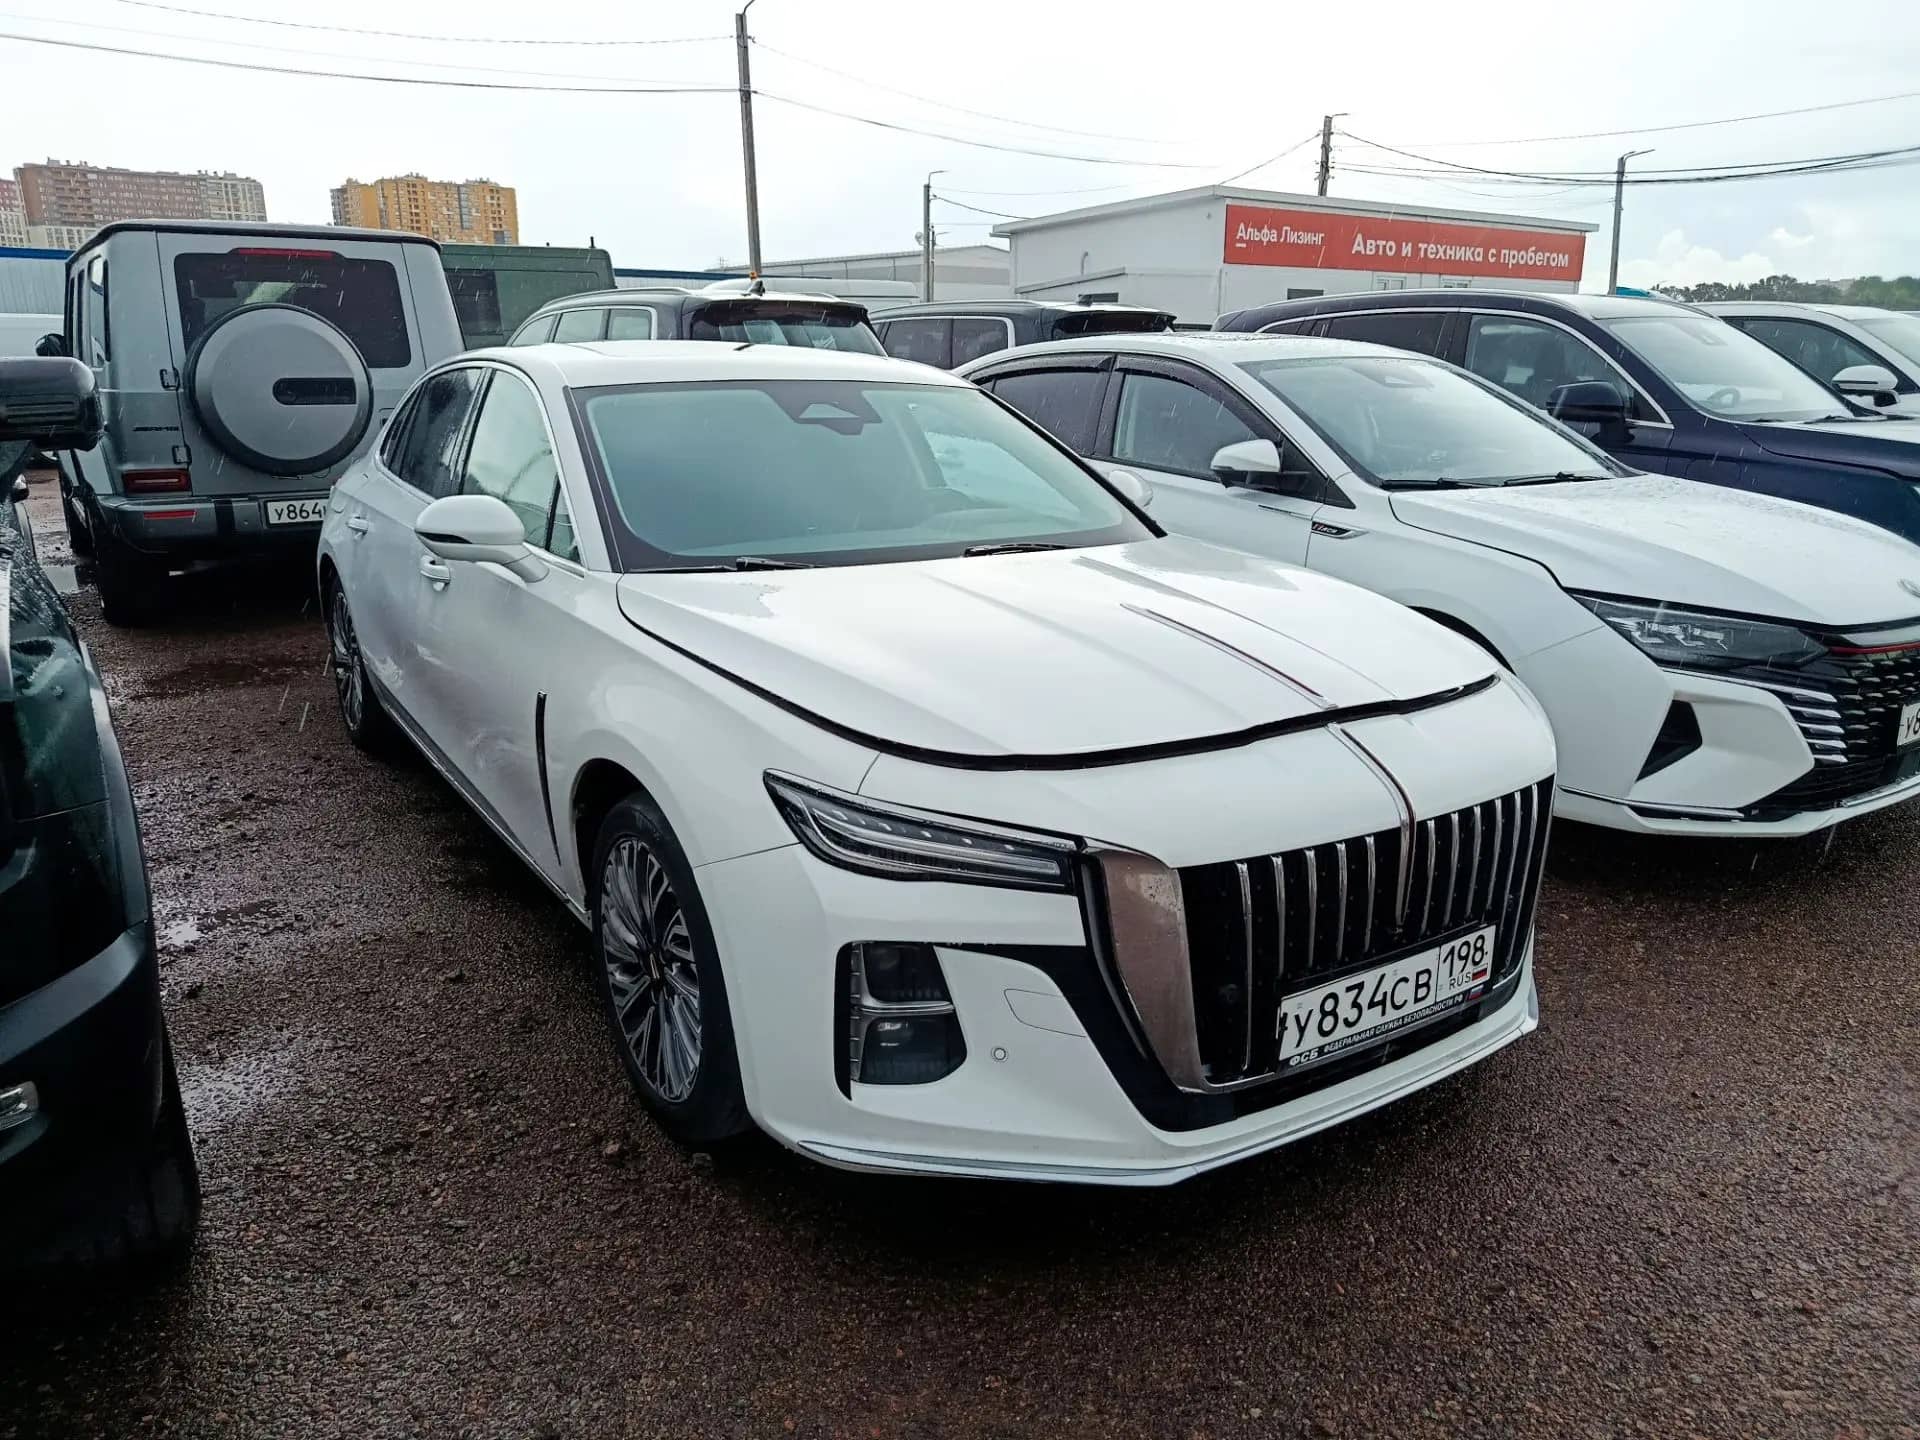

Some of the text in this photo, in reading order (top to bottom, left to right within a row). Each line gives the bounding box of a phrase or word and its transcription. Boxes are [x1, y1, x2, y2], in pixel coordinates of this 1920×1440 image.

[1236, 222, 1325, 246] Альфа Лизинг
[1352, 233, 1569, 269] Авто и техника с пробегом
[1443, 934, 1486, 978] 198
[1449, 971, 1472, 990] RUS
[1289, 1048, 1319, 1066] ФСБ
